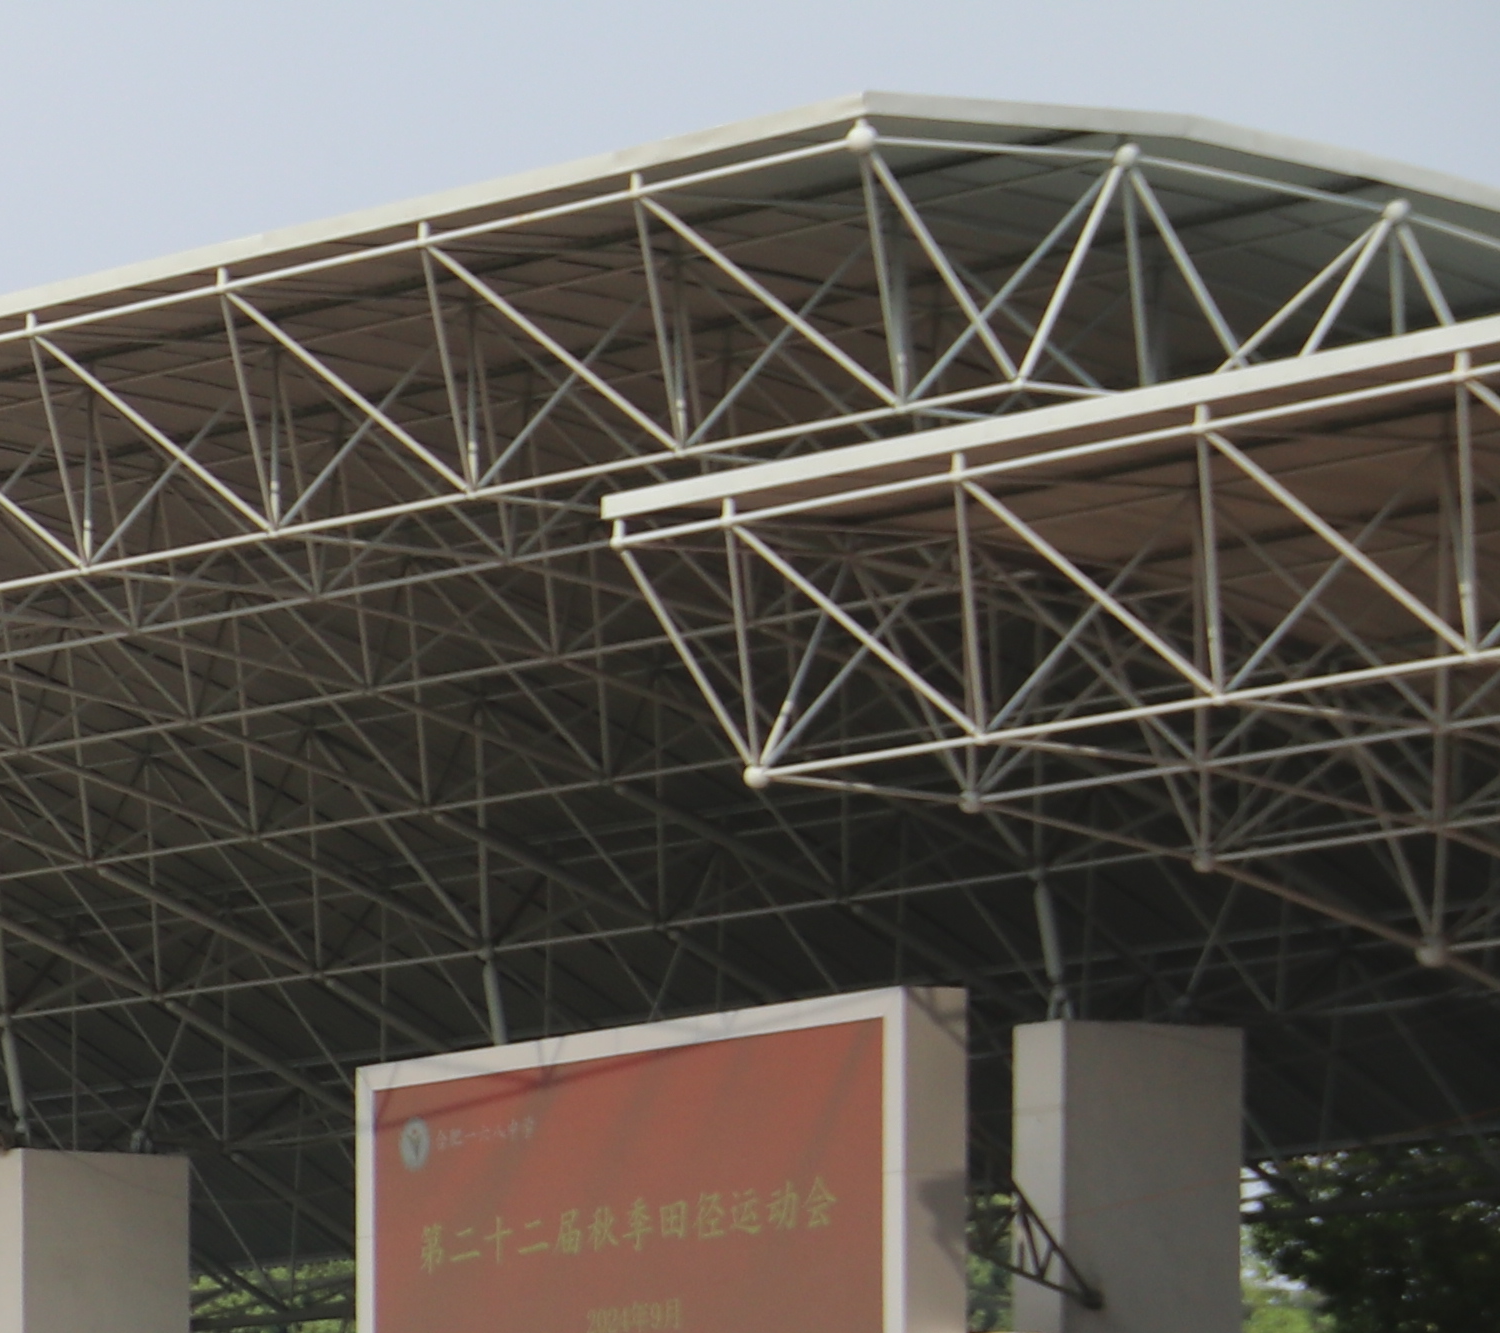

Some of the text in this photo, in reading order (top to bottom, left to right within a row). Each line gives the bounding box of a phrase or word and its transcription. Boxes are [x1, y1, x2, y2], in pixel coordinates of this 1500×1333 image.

[419, 1175, 838, 1274] 第二十二届秋季田径运动会
